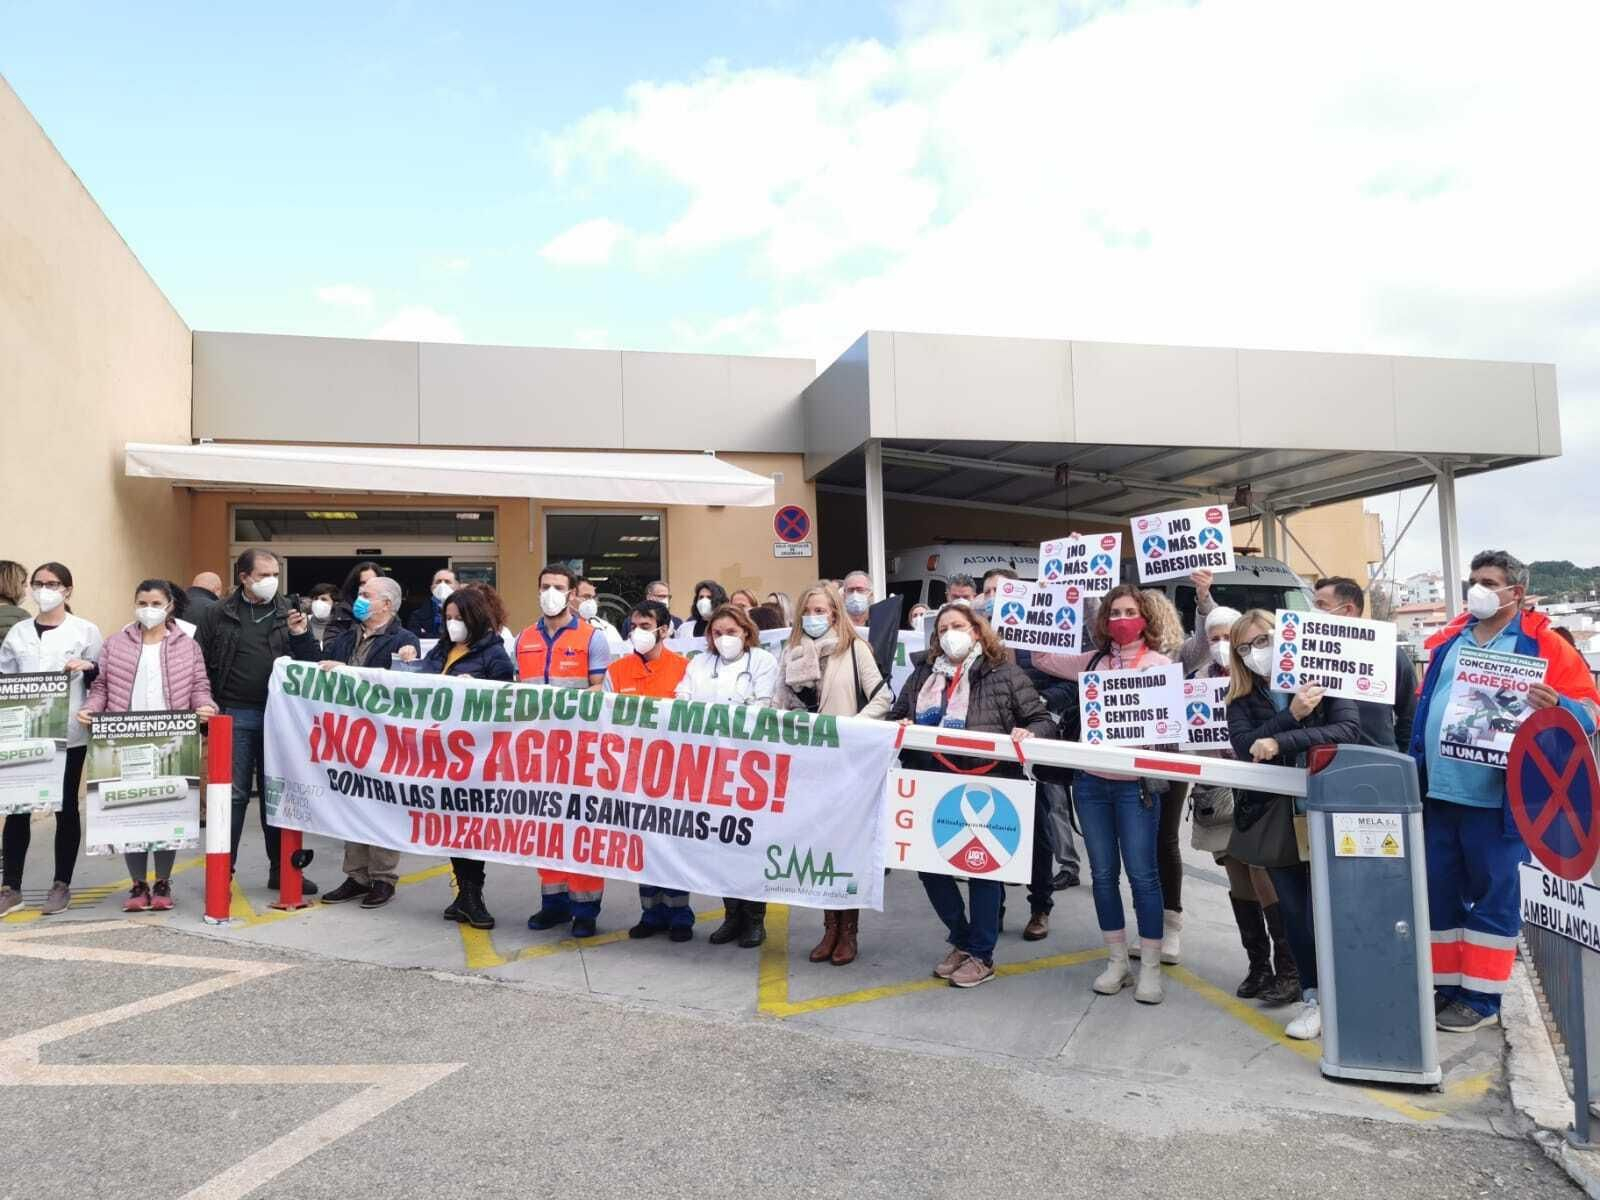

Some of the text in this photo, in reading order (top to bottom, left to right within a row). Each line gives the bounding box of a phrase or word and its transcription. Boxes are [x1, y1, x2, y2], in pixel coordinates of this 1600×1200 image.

[1168, 518, 1191, 535] ¡NO
[1067, 544, 1086, 559] ¡NO
[1167, 535, 1197, 553] MÁS
[1064, 560, 1088, 575] MÁS
[1145, 552, 1227, 576] AGRESIONES!
[1032, 593, 1053, 607] ¡NO
[1026, 609, 1053, 626] MÁS
[997, 626, 1075, 648] AGRESIONES!
[1302, 621, 1375, 641] ¡SEGURIDAD
[1302, 638, 1341, 654] EN LOS
[1301, 656, 1356, 674] CENTROS
[1359, 663, 1374, 676] DE
[1103, 674, 1166, 691] ¡SEGURIDAD
[282, 664, 453, 721] SINDICATO
[461, 684, 604, 722] MÉDICO
[612, 693, 658, 729] DE
[1104, 694, 1117, 706] EN
[1120, 693, 1140, 705] LOS
[1105, 709, 1154, 723] CENTROS
[1156, 707, 1168, 719] DE
[92, 720, 197, 733] RECOMENDADO
[1106, 726, 1144, 739] SALUD!
[1441, 744, 1454, 755] NI
[1456, 747, 1485, 761] UNA
[309, 712, 791, 813] ¡NO MÁS AGRESIONES!
[105, 784, 176, 802] RESPETO
[327, 768, 753, 846] CONTRA LAS AGRESIONES A SANITARIAS-OS
[408, 811, 644, 872] TOLERANCIA CERO
[1542, 874, 1585, 910] SALIDA
